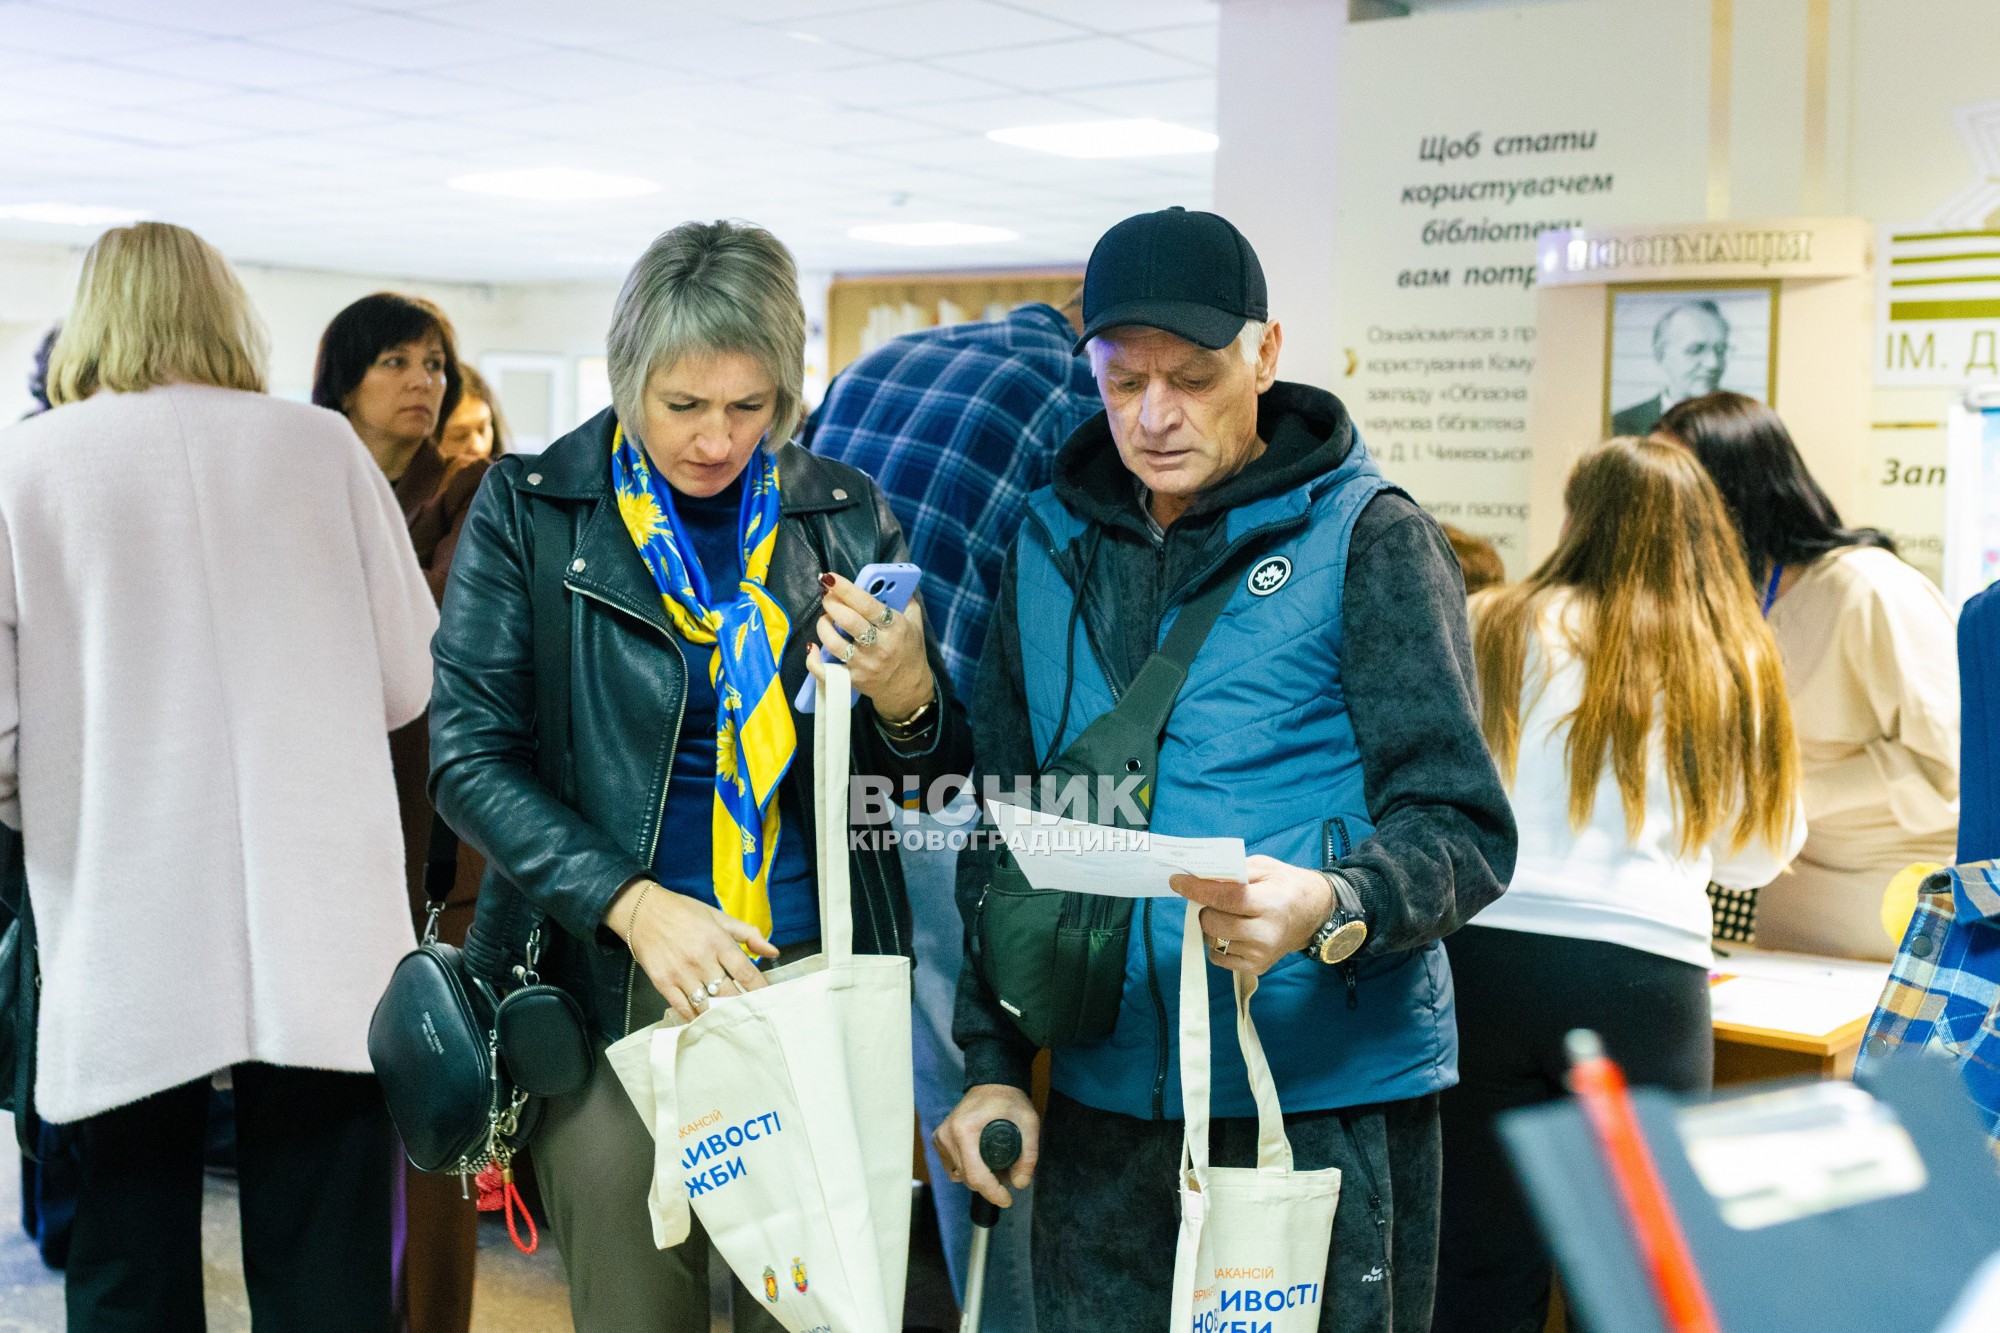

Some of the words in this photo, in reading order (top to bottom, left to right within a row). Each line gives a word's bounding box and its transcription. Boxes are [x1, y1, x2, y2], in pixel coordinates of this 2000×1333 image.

[1418, 130, 1482, 164] Щоб
[1493, 129, 1598, 157] стати
[1400, 172, 1614, 208] користувачем
[1545, 231, 1813, 272] ФОРМАЦІЯ
[1397, 267, 1450, 288] вам
[1886, 331, 1947, 370] ІМ.
